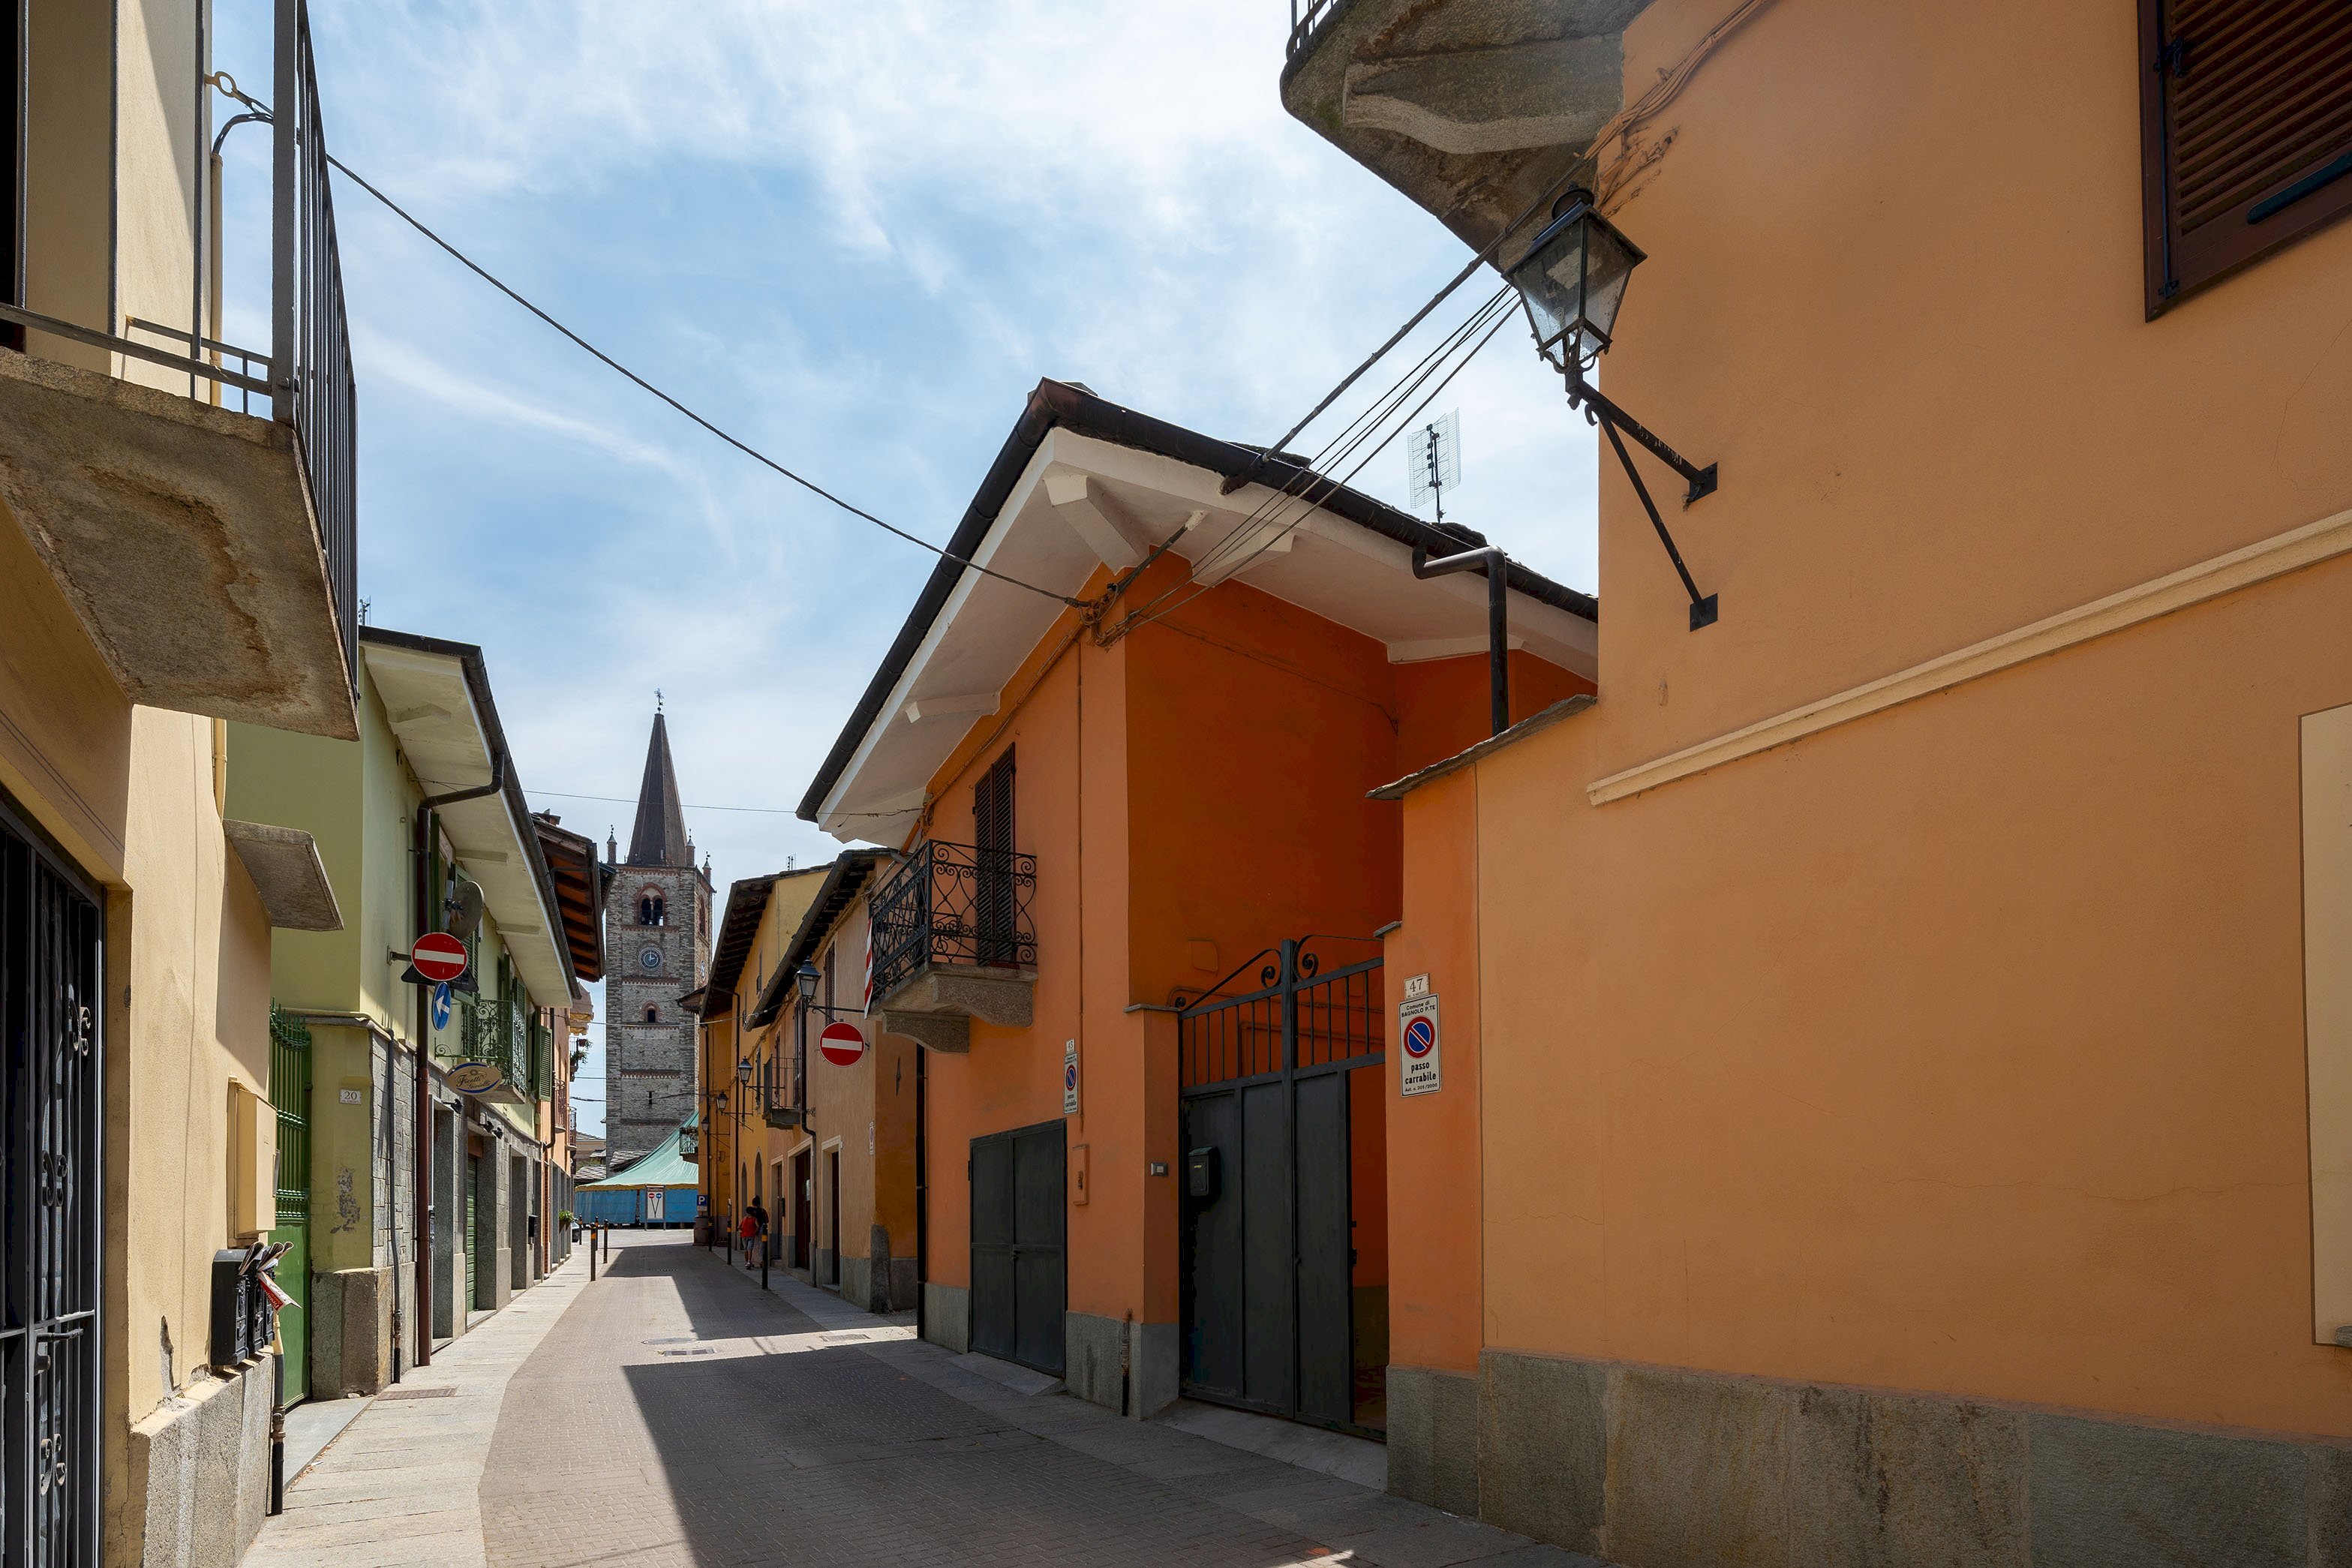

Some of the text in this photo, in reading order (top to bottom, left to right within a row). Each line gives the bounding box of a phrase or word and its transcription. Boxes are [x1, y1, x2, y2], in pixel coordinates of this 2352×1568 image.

[1409, 978, 1423, 993] 47
[1406, 1002, 1424, 1011] Comune
[1401, 1008, 1424, 1017] BAGNOLO
[1410, 1062, 1430, 1074] passo
[1404, 1071, 1437, 1085] carrabile
[344, 1091, 358, 1101] 20
[698, 1196, 705, 1205] P
